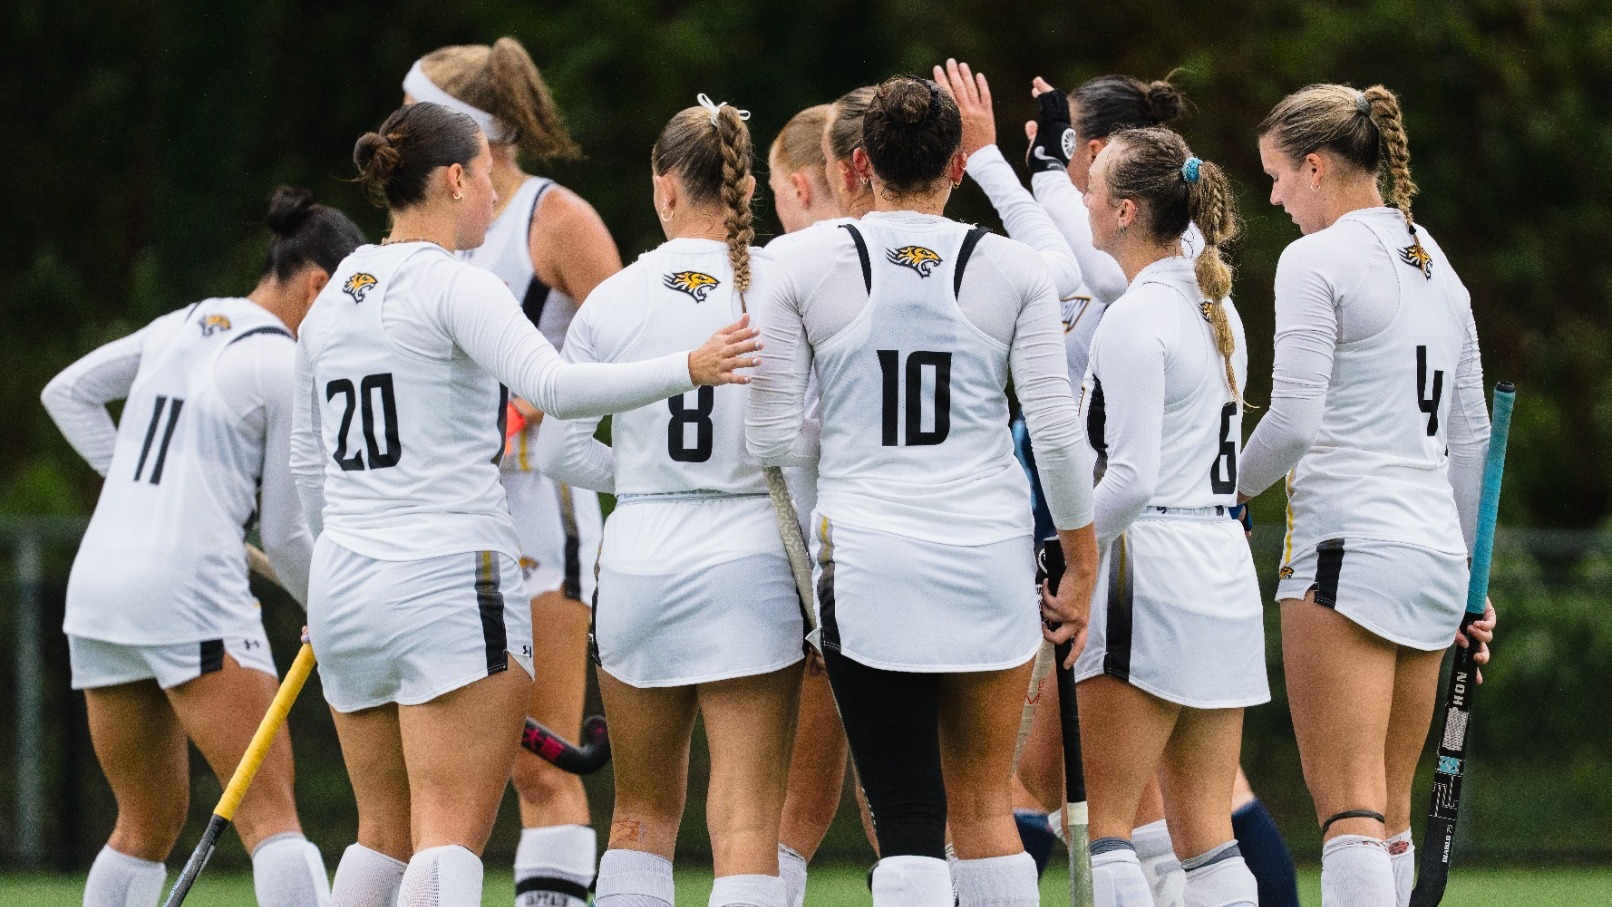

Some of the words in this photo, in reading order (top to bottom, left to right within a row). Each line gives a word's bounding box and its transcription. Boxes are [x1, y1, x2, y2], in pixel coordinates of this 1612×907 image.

[325, 373, 402, 471] 20
[667, 384, 714, 463] 8
[877, 350, 953, 447] 10
[1415, 345, 1444, 436] 4
[134, 396, 184, 485] 11
[1210, 402, 1238, 495] 6
[1441, 835, 1452, 864] DIABLO
